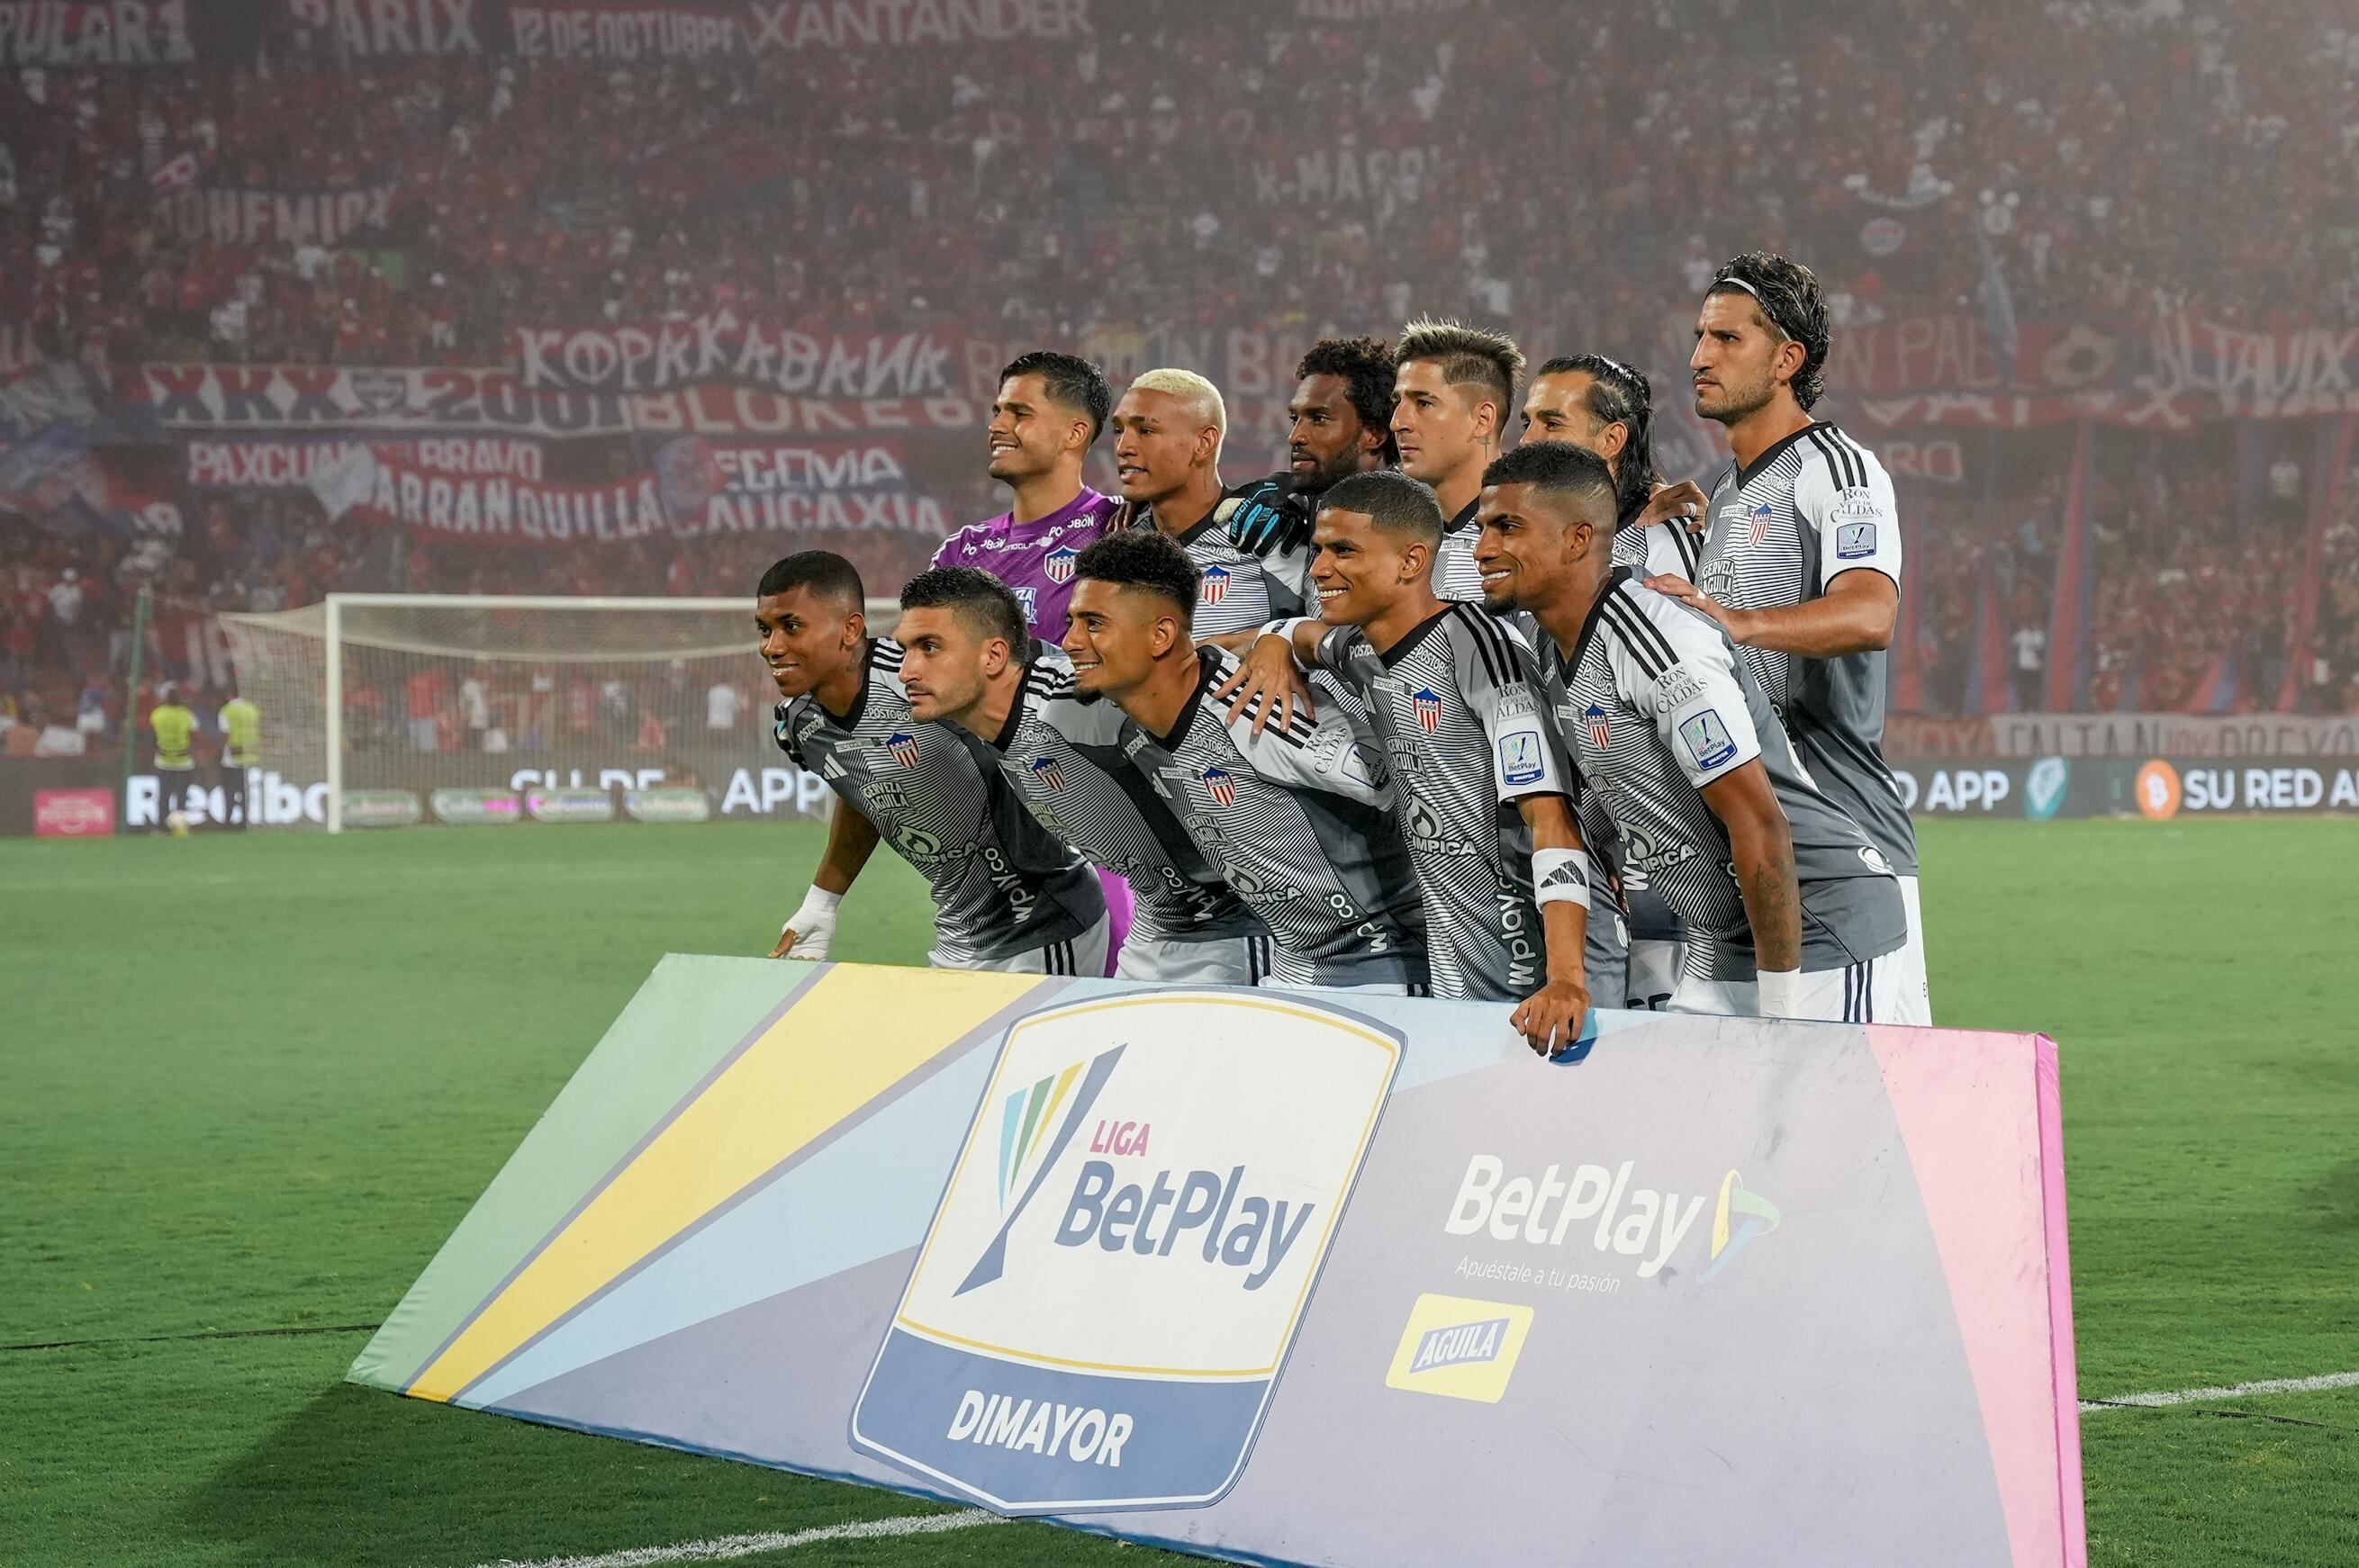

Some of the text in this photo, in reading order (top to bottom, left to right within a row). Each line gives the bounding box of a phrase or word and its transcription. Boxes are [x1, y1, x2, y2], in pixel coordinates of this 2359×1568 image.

[1842, 488, 1871, 500] RON
[1498, 684, 1527, 698] RON
[1657, 667, 1686, 690] RON
[868, 706, 913, 722] POSTOBÓ
[1497, 700, 1541, 718] ALDAS
[1306, 726, 1327, 752] RON
[1698, 739, 1726, 758] BetPlay
[1507, 761, 1536, 772] BetPlay
[720, 767, 827, 815] APP
[1925, 770, 2010, 810] APP
[2183, 770, 2237, 810] SU
[2245, 770, 2324, 808] RED
[1089, 1120, 1151, 1157] LIGA
[1054, 1160, 1315, 1291] BetPlay
[1444, 1154, 1706, 1278] BetPlay
[1455, 1256, 1621, 1294] Apuéstale a tu pasión
[947, 1390, 1134, 1467] DIMAYOR
